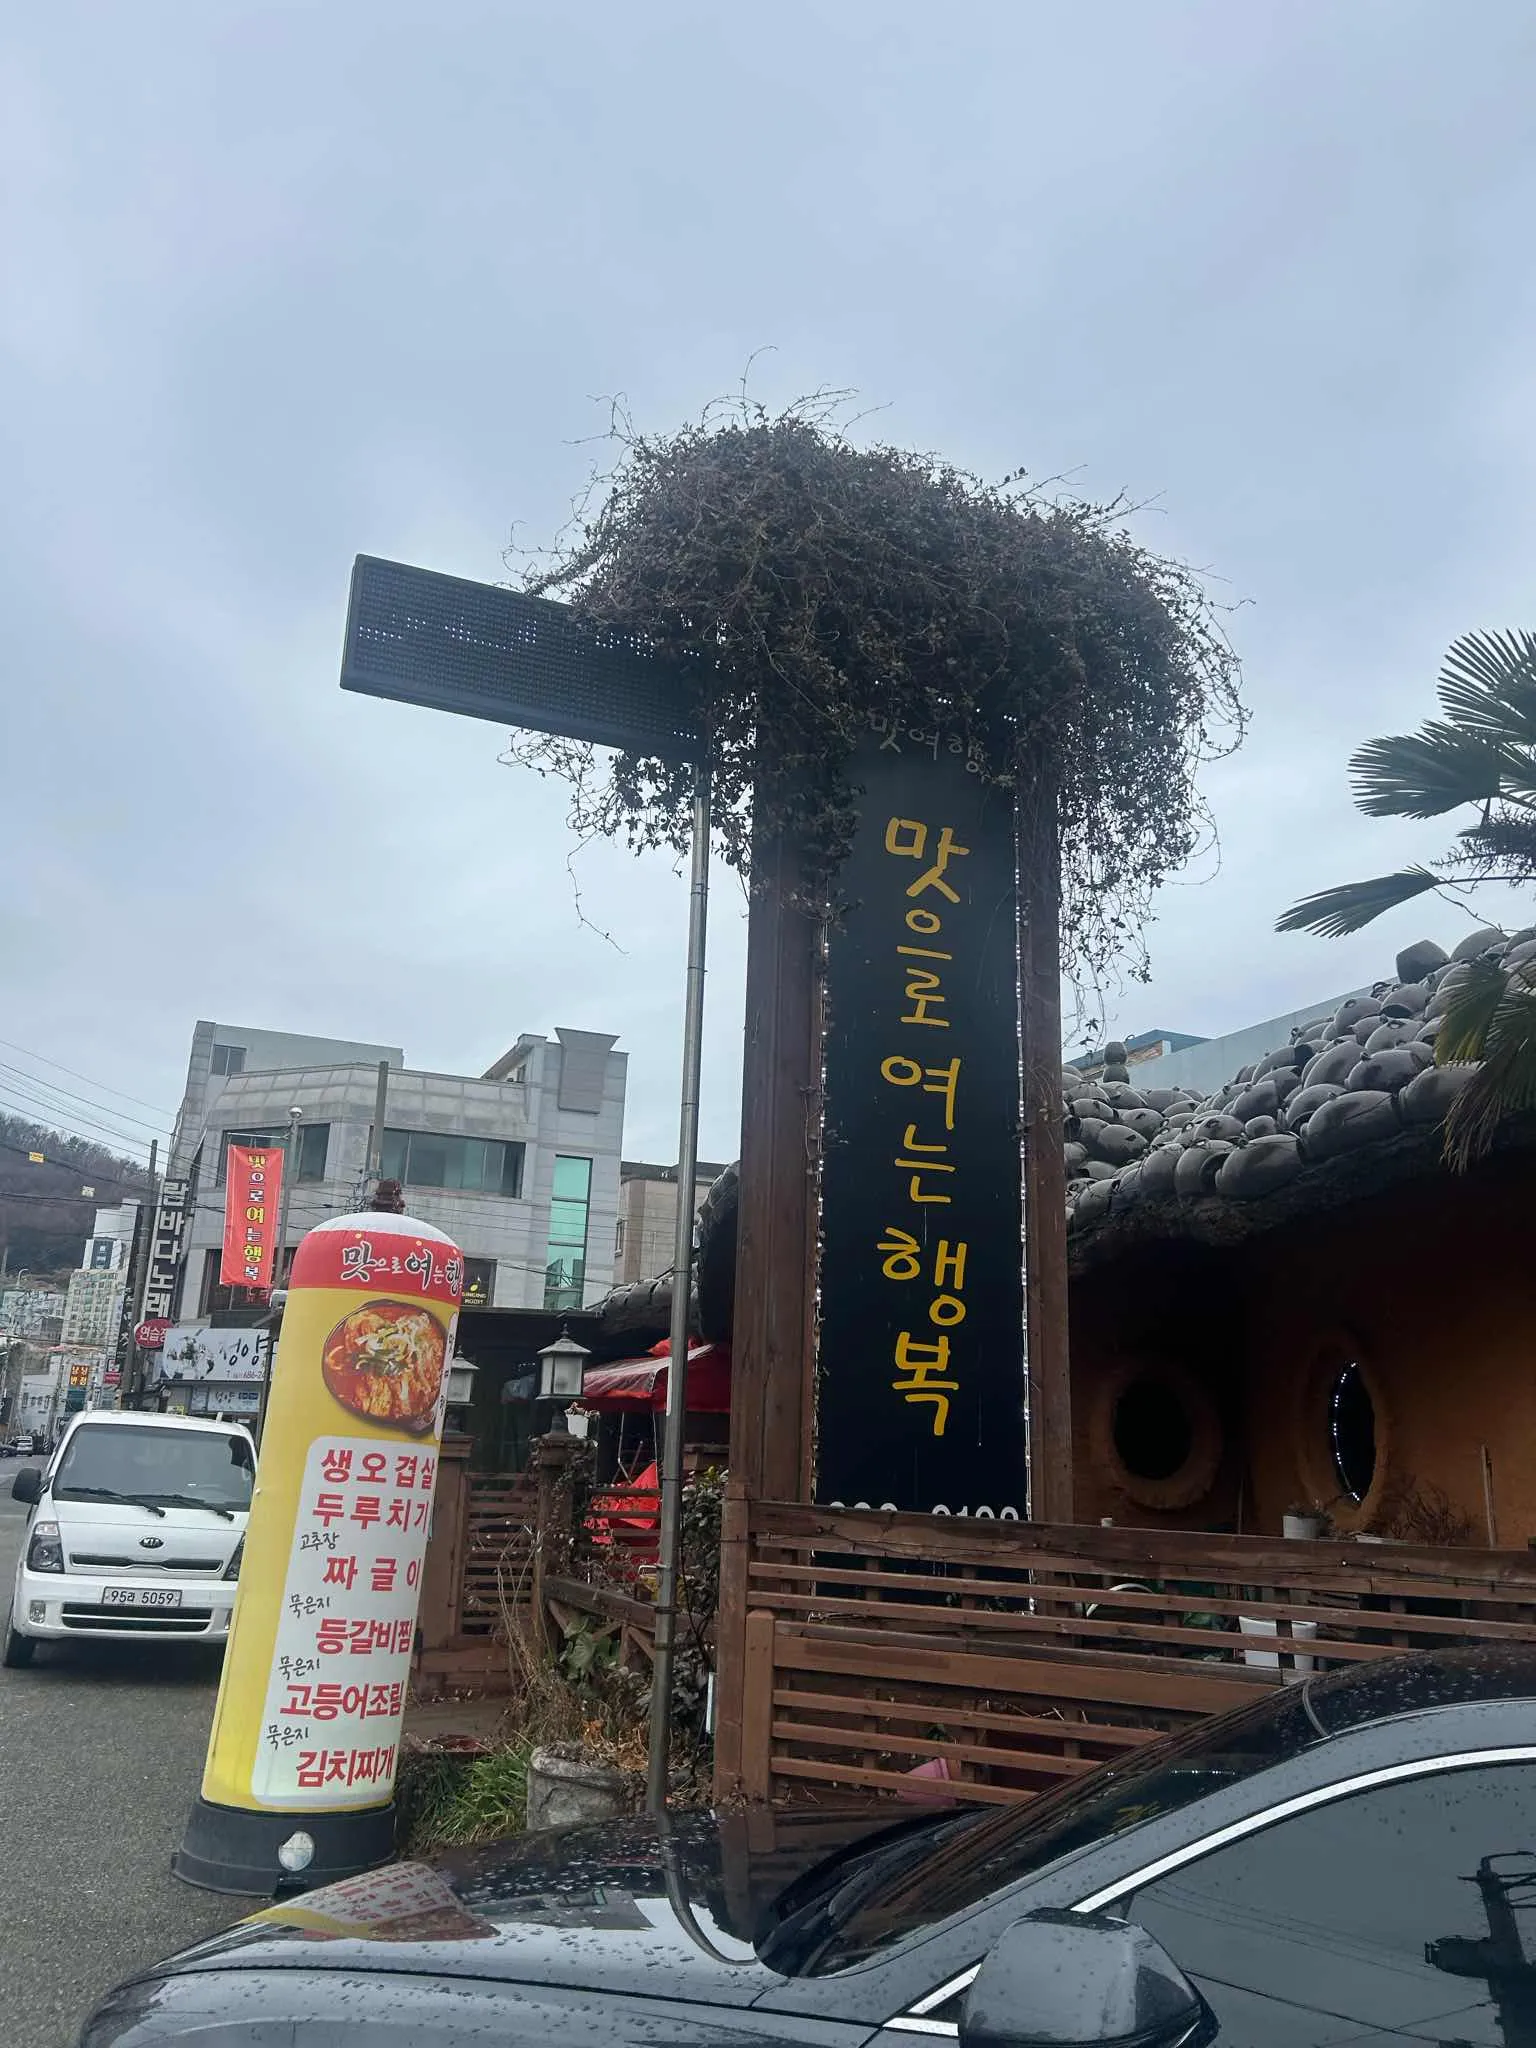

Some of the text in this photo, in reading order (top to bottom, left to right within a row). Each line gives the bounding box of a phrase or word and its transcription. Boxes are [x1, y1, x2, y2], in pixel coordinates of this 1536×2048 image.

[312, 1493, 429, 1534] 두루치기
[300, 1532, 340, 1551] 고추장
[141, 1591, 174, 1605] 5059
[289, 1594, 331, 1618] 묵은지
[316, 1618, 412, 1654] 등갈비찜
[278, 1656, 320, 1681] 묵은지
[279, 1680, 404, 1720] 고등어조림
[266, 1725, 309, 1749] 묵은지
[295, 1748, 394, 1788] 김치찌개
